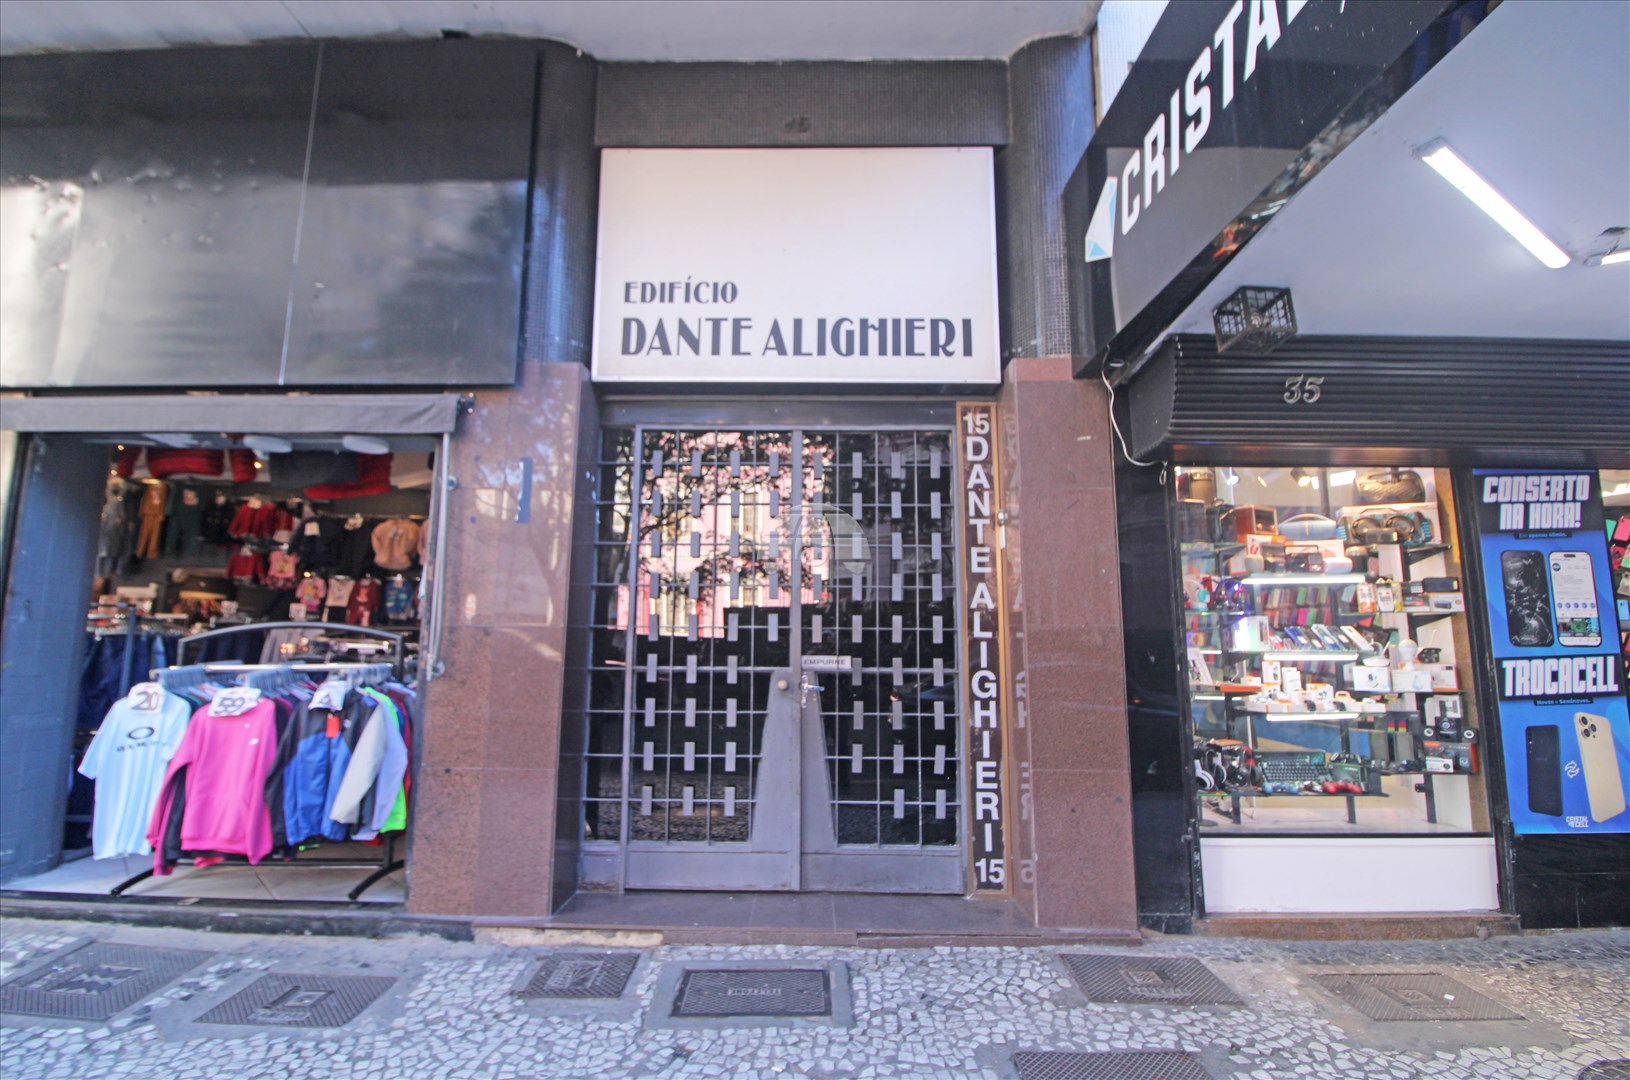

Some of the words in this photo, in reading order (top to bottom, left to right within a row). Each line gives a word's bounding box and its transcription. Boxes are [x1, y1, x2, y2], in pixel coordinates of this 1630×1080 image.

[1121, 0, 1309, 235] CRISTA
[624, 275, 738, 304] EDIFÍCIO
[621, 317, 753, 356] DANTE
[762, 317, 973, 357] ALIGHIERI
[1283, 374, 1325, 404] 35
[963, 413, 990, 435] 15
[1482, 475, 1590, 503] CONSERTO
[966, 436, 992, 573] DANTE
[1499, 503, 1525, 530] NA
[1528, 502, 1582, 529] HORA!
[1502, 656, 1619, 697] TROCACELL
[131, 691, 159, 711] 20
[970, 583, 1000, 852] ALIGHIERI
[975, 858, 1005, 884] 15
